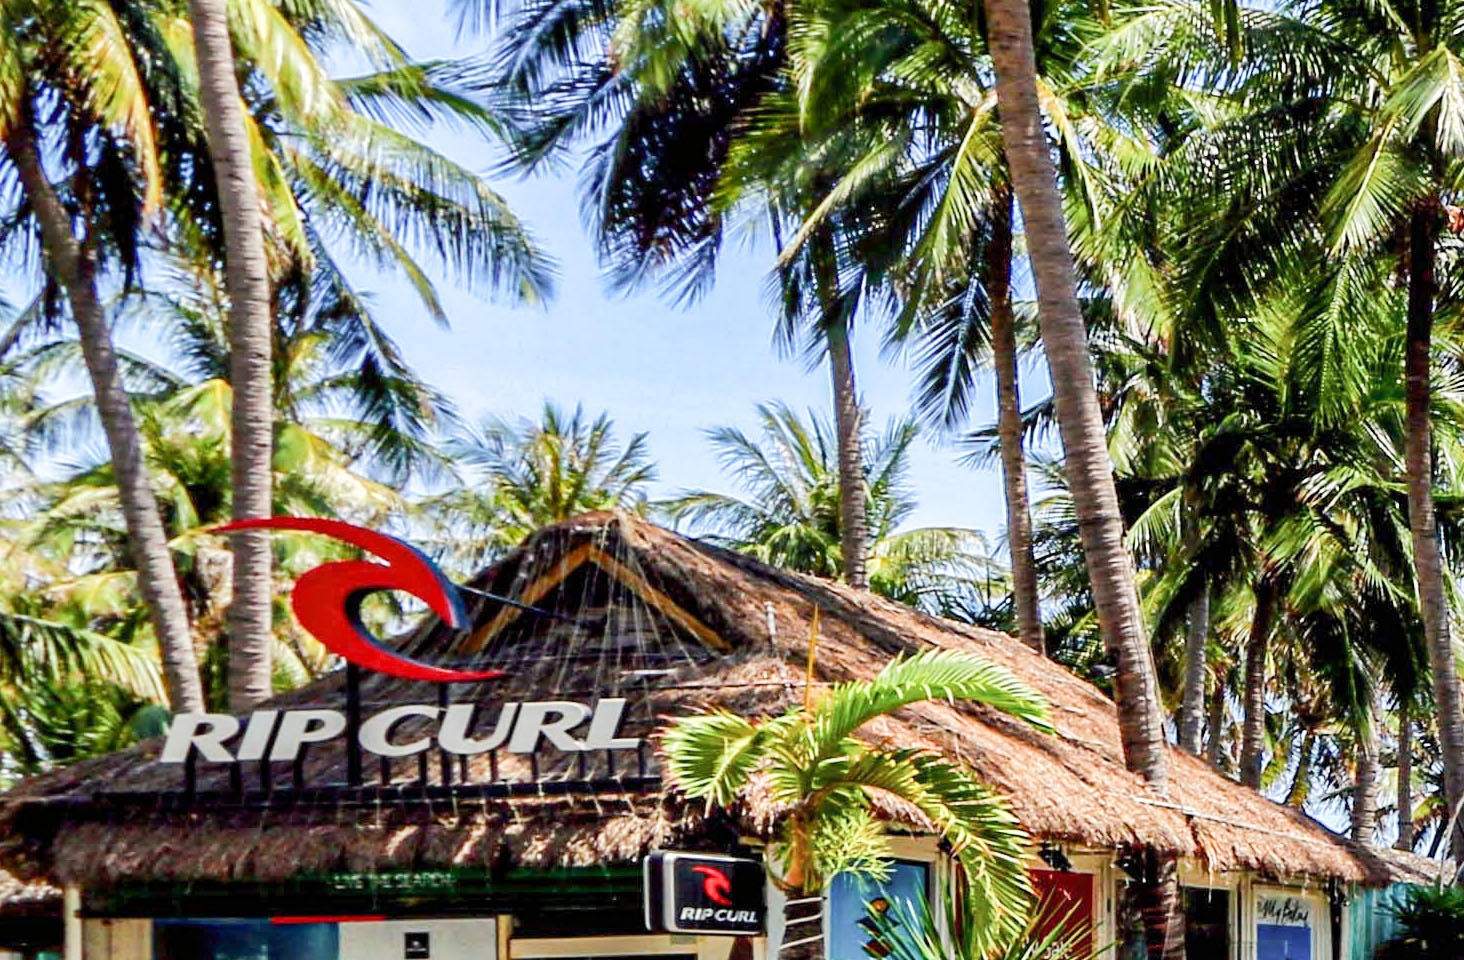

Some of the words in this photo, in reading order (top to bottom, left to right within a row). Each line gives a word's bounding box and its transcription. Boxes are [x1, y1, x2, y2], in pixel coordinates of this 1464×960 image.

[159, 708, 346, 763] RIP
[357, 697, 641, 757] CURL
[680, 906, 713, 921] RIP
[714, 909, 758, 923] CURL
